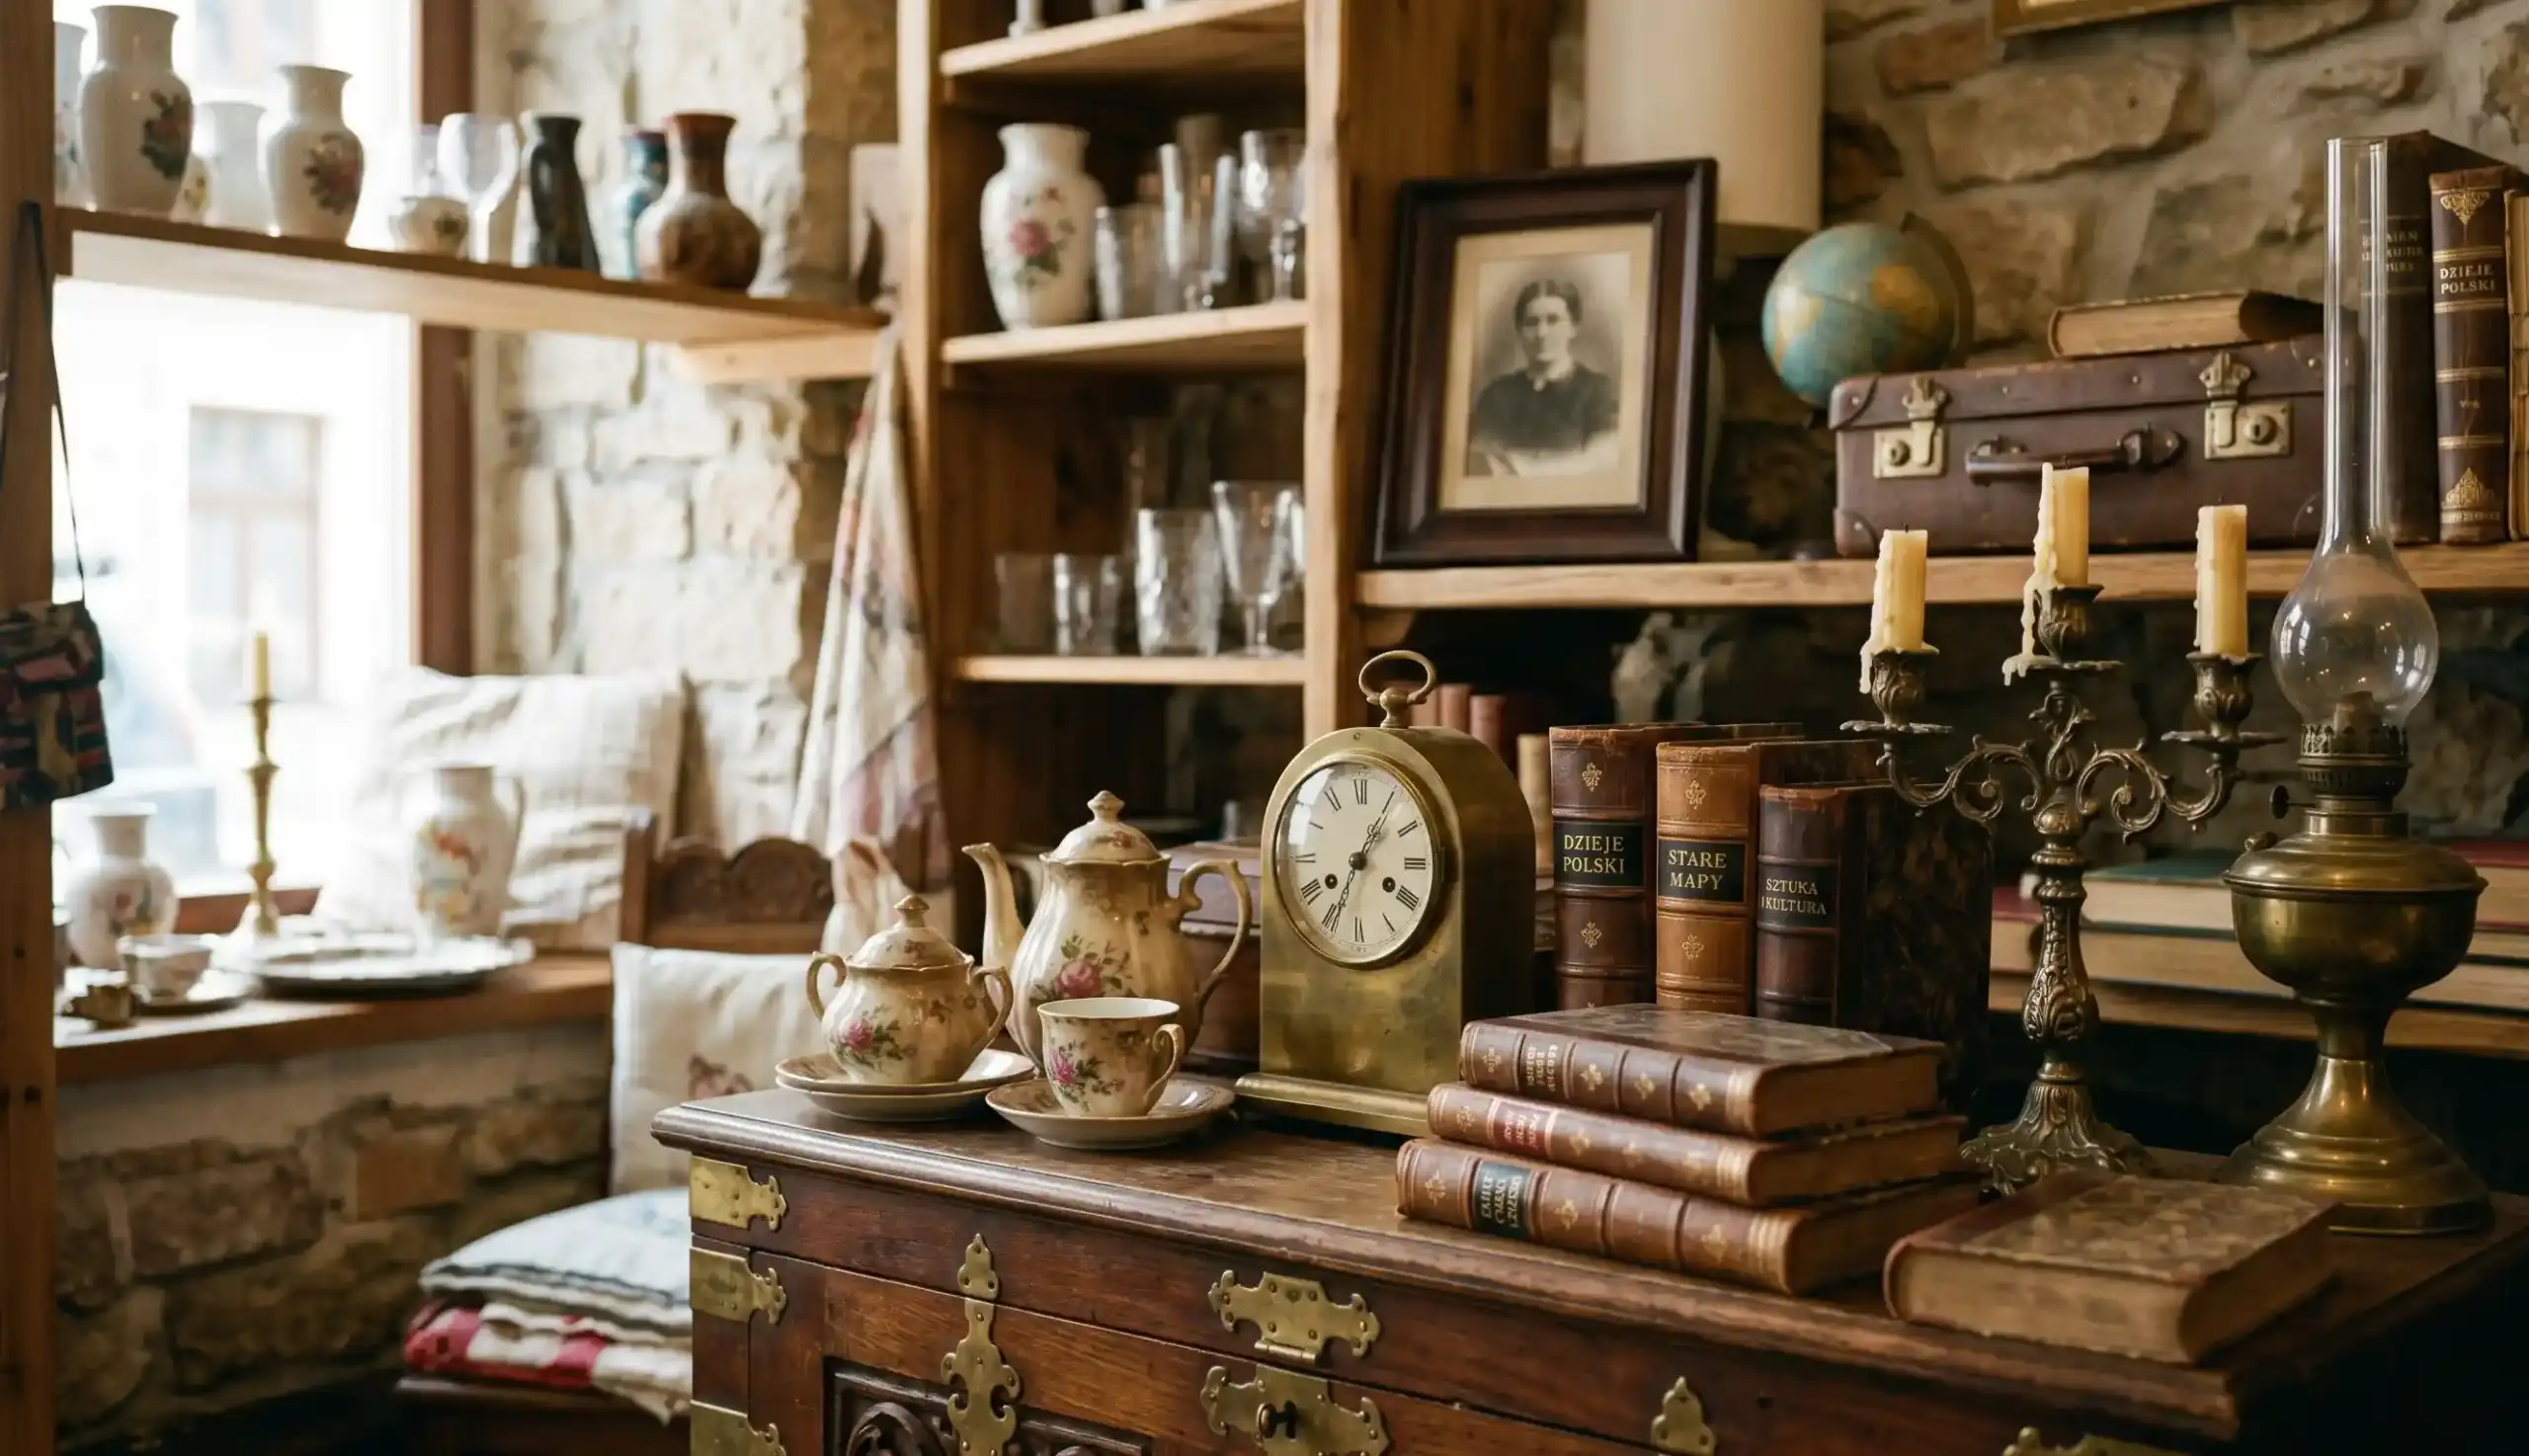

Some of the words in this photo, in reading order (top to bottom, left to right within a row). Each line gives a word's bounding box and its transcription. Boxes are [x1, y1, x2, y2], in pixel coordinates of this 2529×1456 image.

[2440, 279, 2495, 294] POLSKI
[1563, 834, 1625, 854] DZIEJE
[1563, 856, 1625, 874] POLSKI
[1668, 849, 1728, 870] STARE
[1670, 872, 1724, 891] MAPY
[1765, 877, 1819, 896] SZTUKA
[1765, 897, 1827, 916] KULTURA
